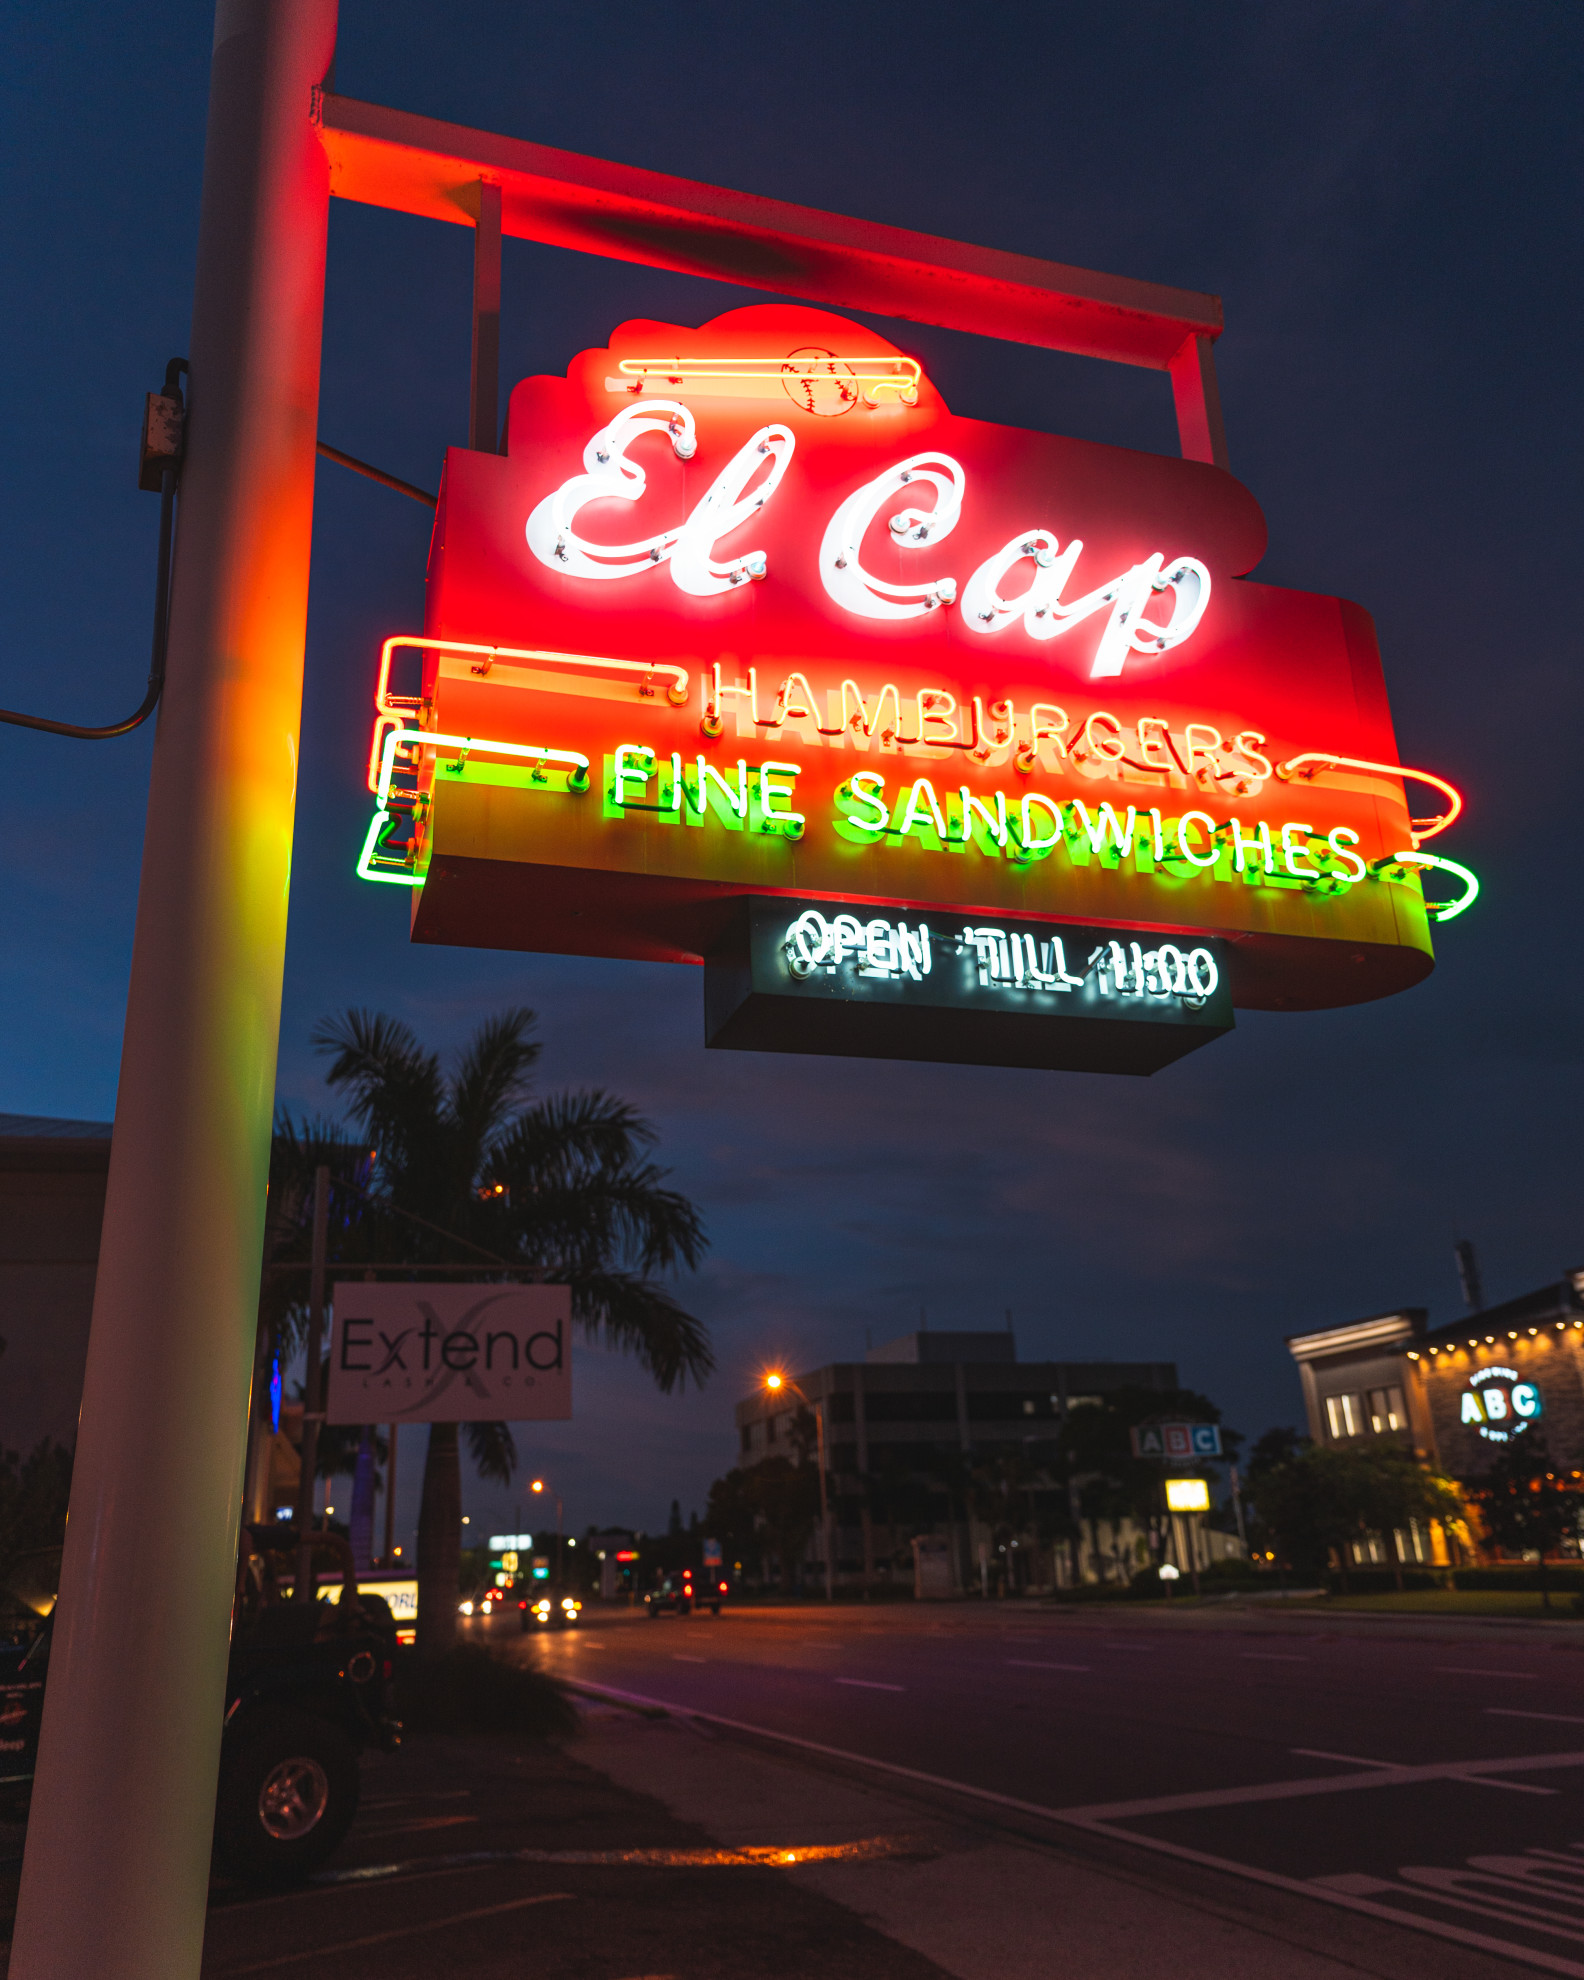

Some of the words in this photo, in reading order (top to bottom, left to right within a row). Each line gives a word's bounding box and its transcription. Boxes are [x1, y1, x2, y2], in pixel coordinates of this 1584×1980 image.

[525, 400, 796, 597] El
[818, 451, 1212, 678] Cap
[703, 661, 1274, 792] HAMBURGERS
[604, 743, 806, 836] FINE
[836, 770, 1367, 893] SANDWICHES
[788, 909, 932, 980] OPEN
[340, 1318, 563, 1376] Extend
[1461, 1384, 1538, 1424] ABC
[1143, 1429, 1213, 1452] ABC
